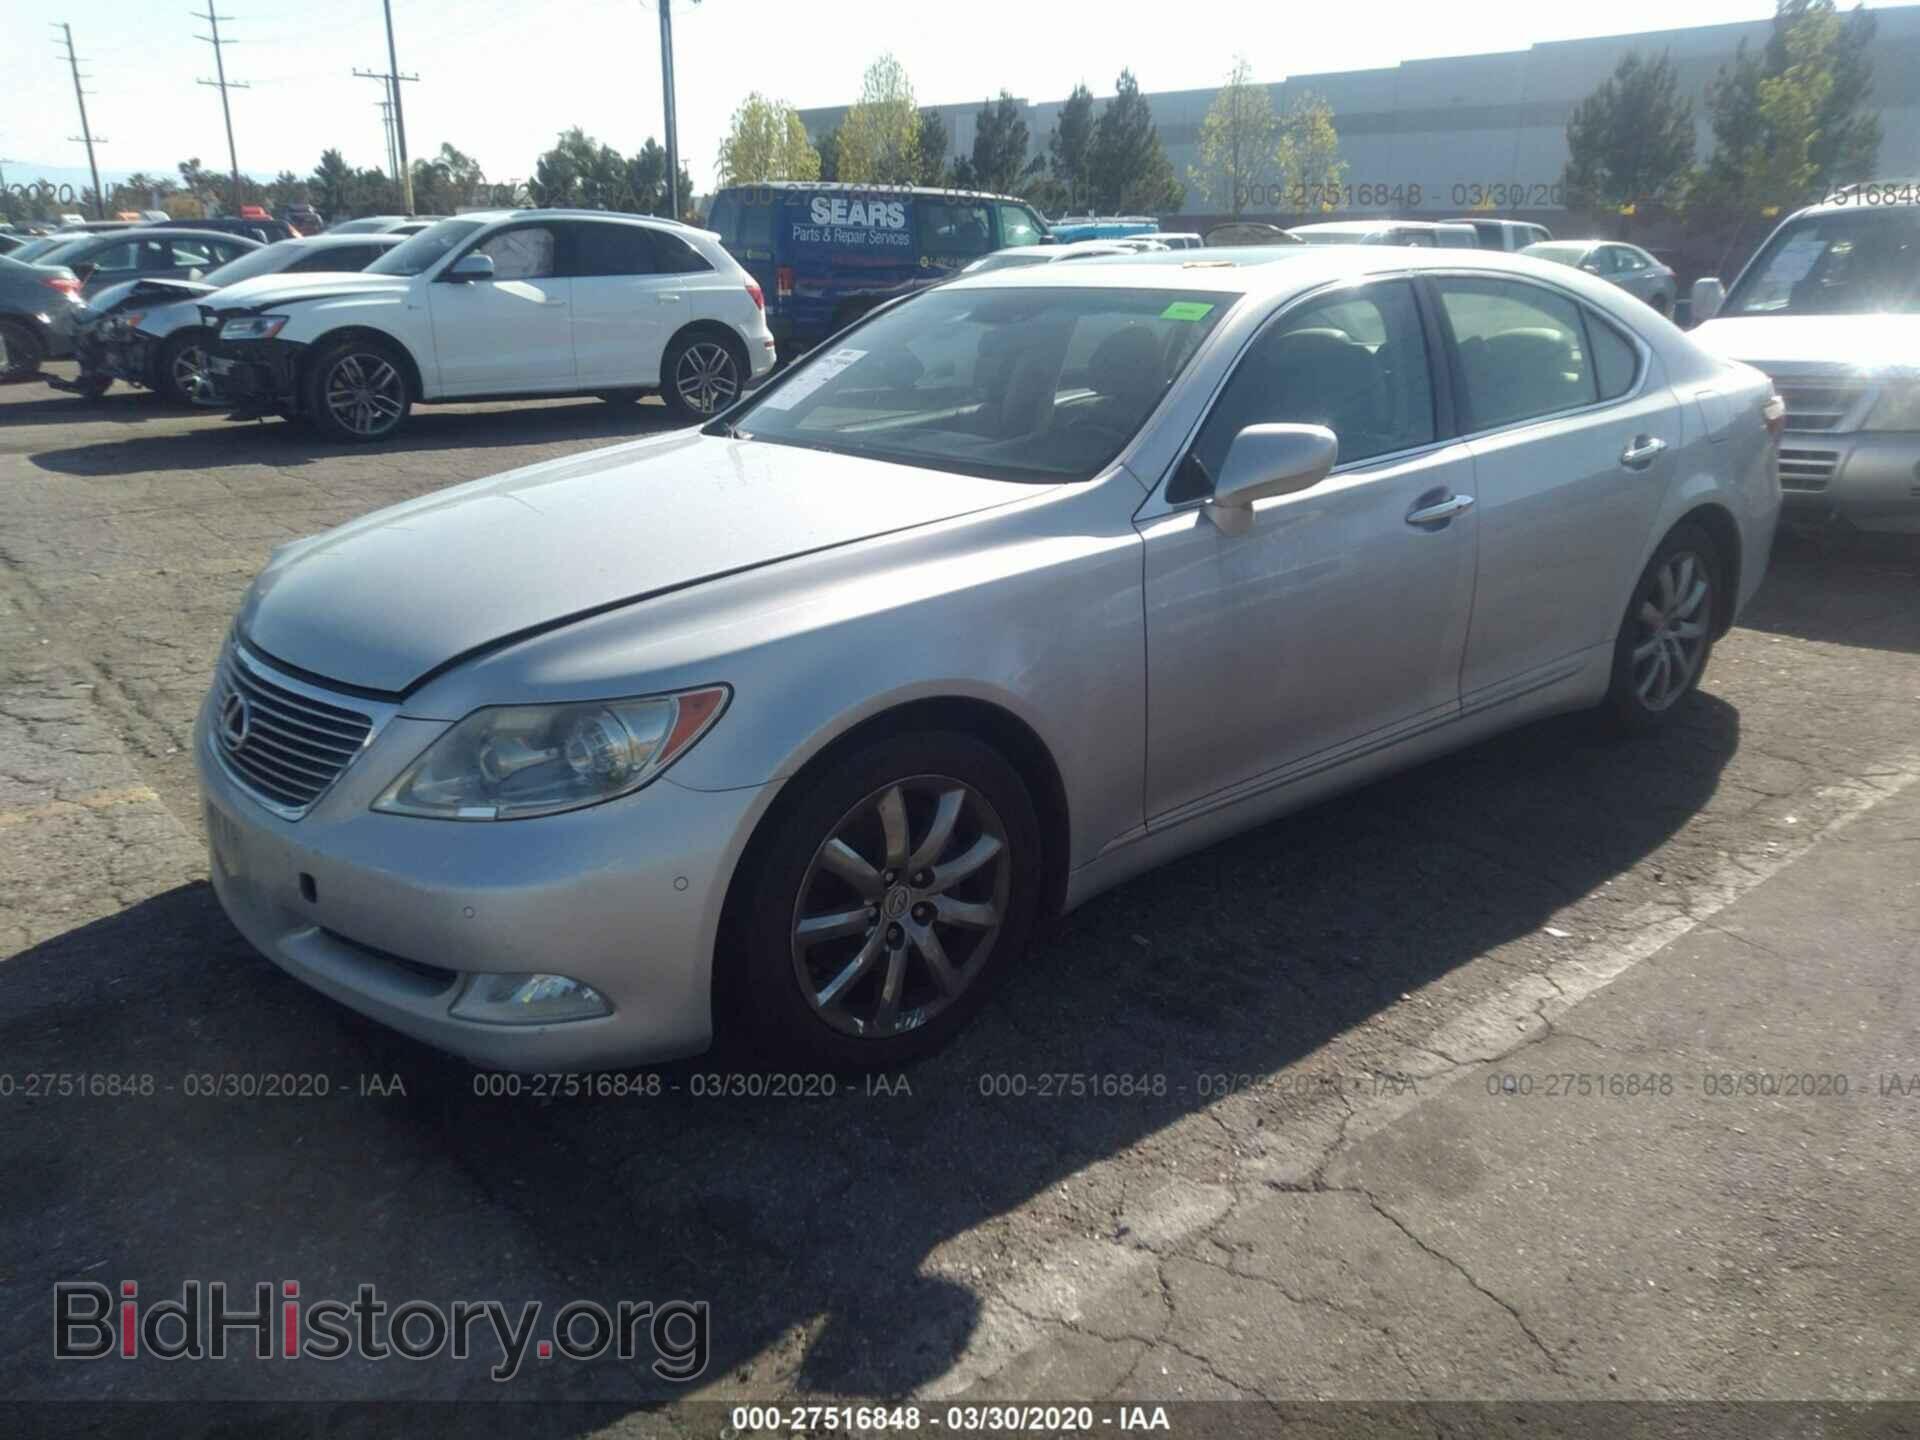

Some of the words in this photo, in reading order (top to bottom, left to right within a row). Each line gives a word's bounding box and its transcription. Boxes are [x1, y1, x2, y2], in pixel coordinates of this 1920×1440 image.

[811, 197, 905, 228] SEARS
[792, 225, 820, 242] Parts
[823, 229, 831, 242] &
[834, 228, 866, 245] Repair
[869, 230, 910, 247] Services
